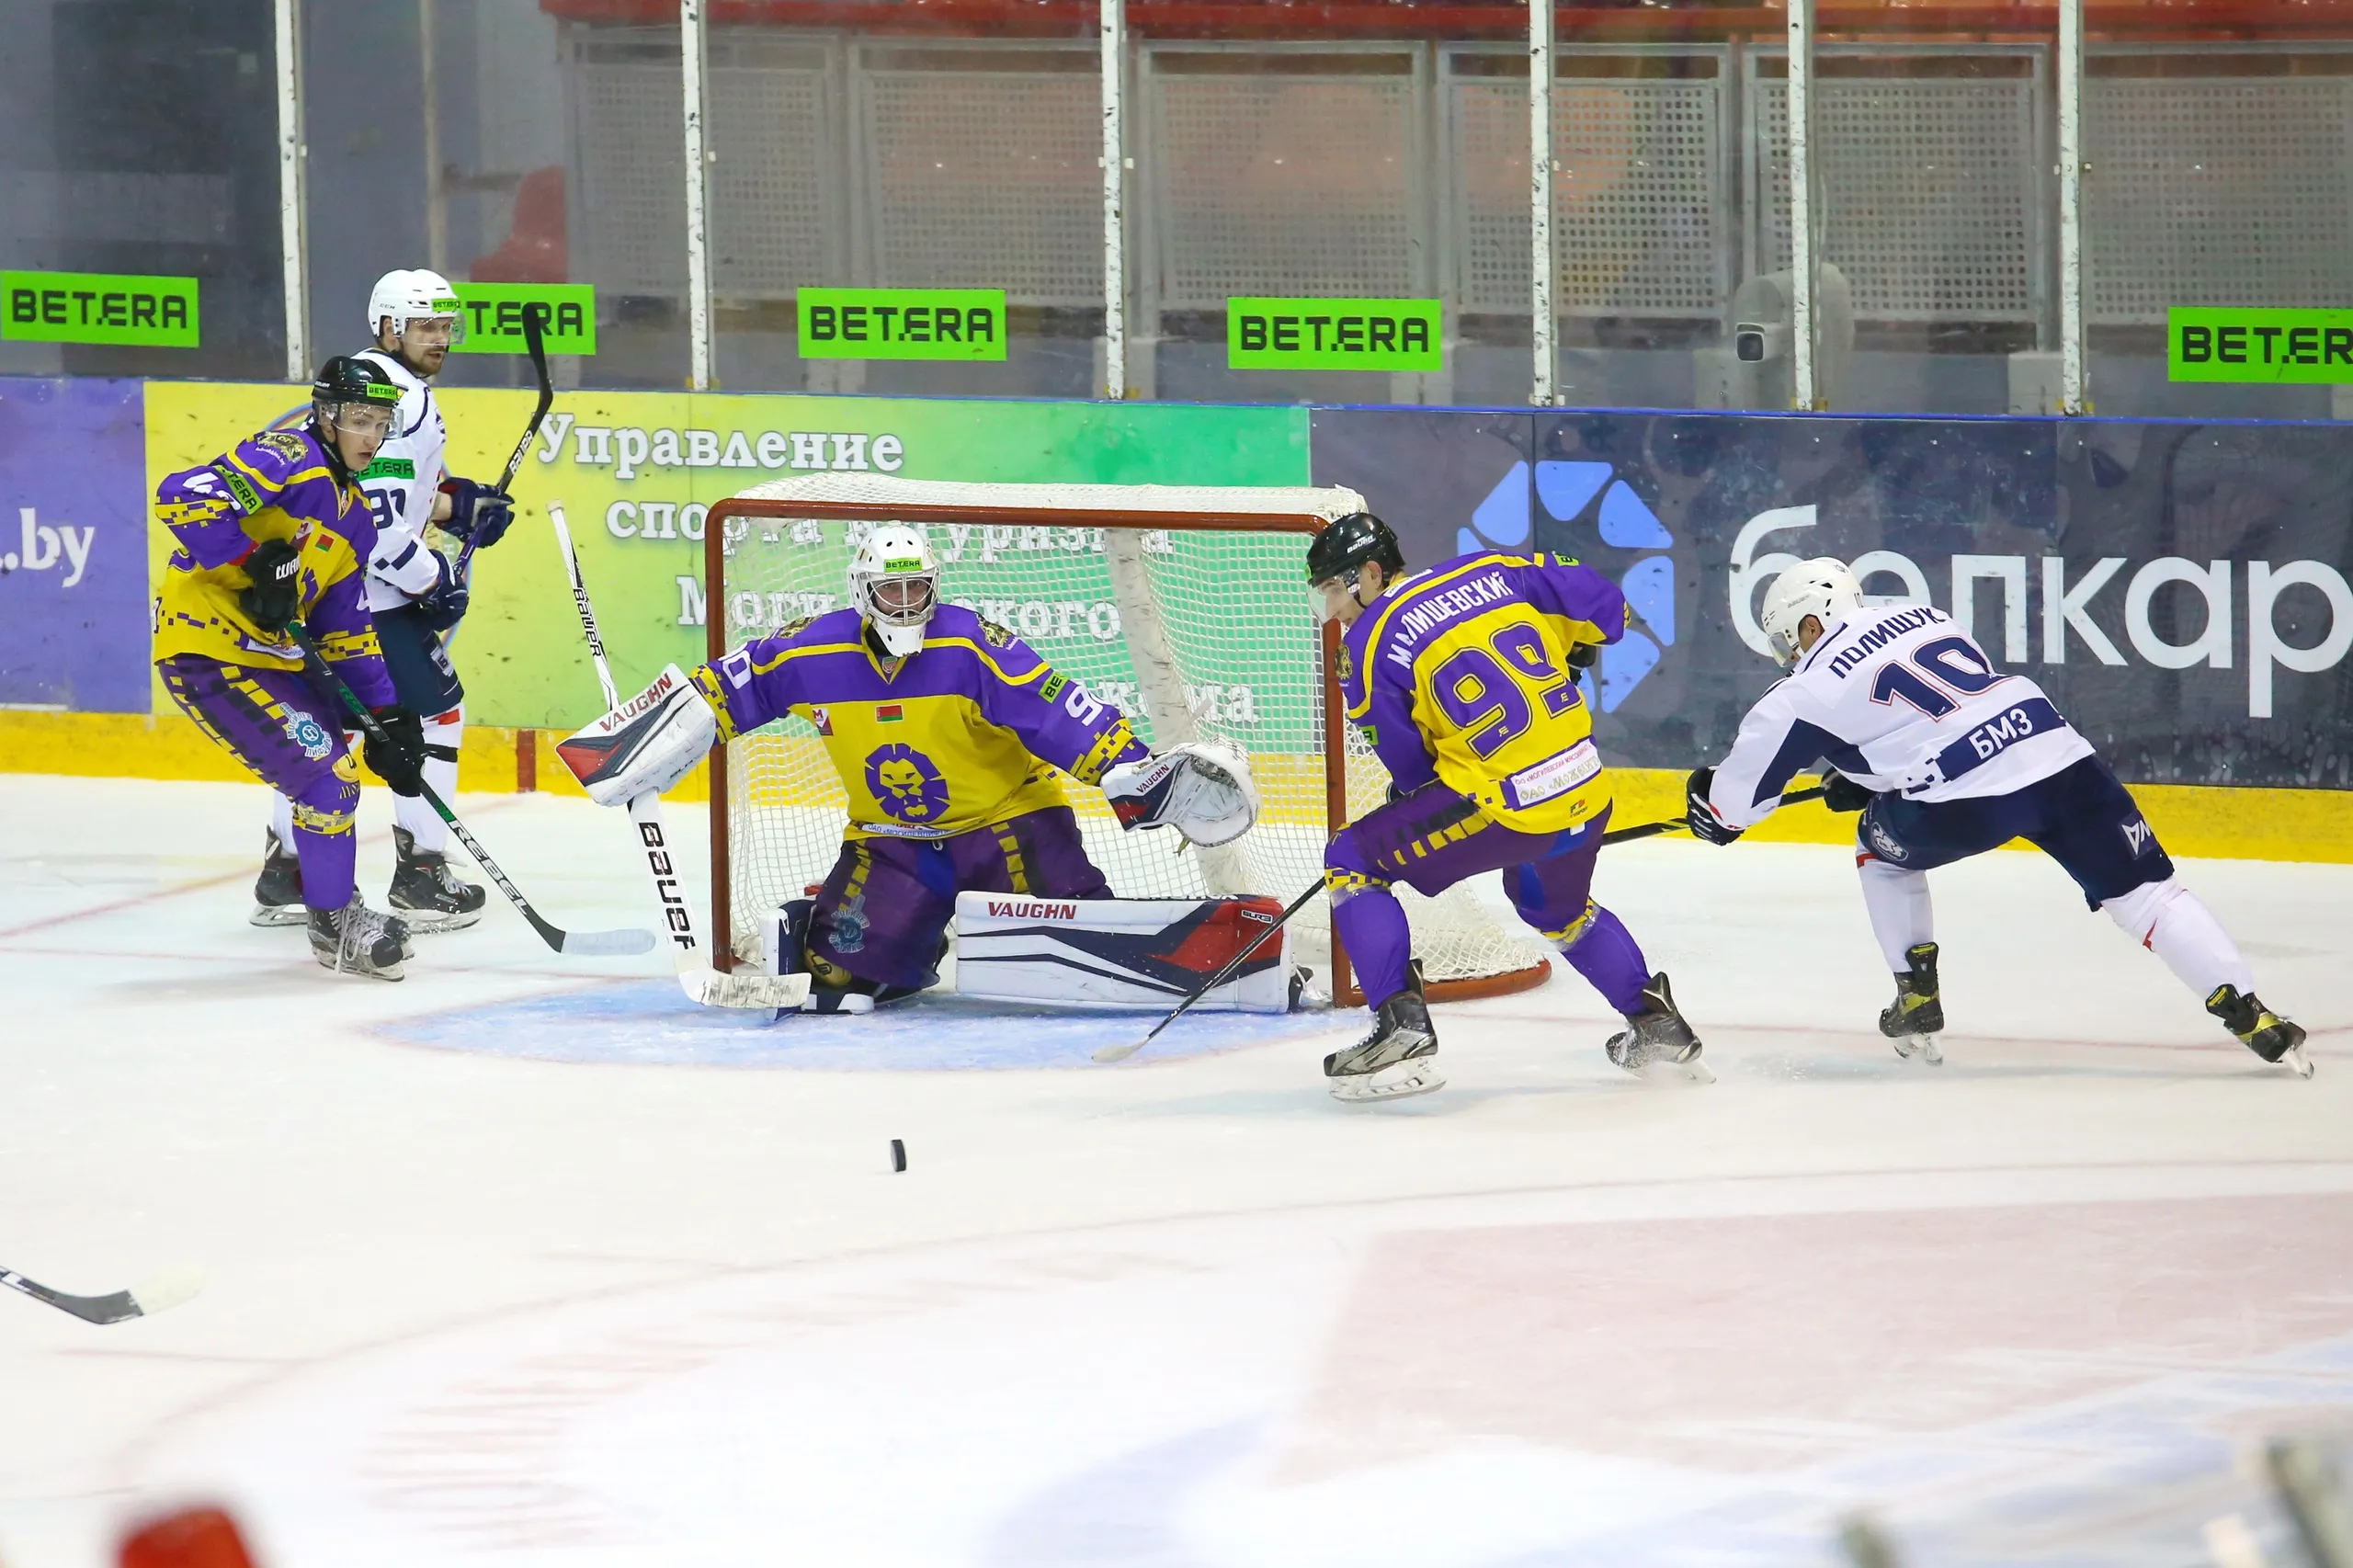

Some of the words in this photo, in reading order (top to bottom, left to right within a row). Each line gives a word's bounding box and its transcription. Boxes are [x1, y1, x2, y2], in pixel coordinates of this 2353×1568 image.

[532, 413, 904, 480] Управление
[0, 507, 96, 588] .by
[1828, 607, 1947, 679] ПОЛИЩУК
[599, 672, 673, 732] VAUGHN
[1430, 621, 1583, 762] 99
[1870, 634, 2013, 722] 10
[1968, 708, 2033, 760] БМЗ
[1136, 764, 1169, 794] VAUGHN
[450, 818, 531, 916] REBEL
[988, 902, 1076, 920] VAUGHN
